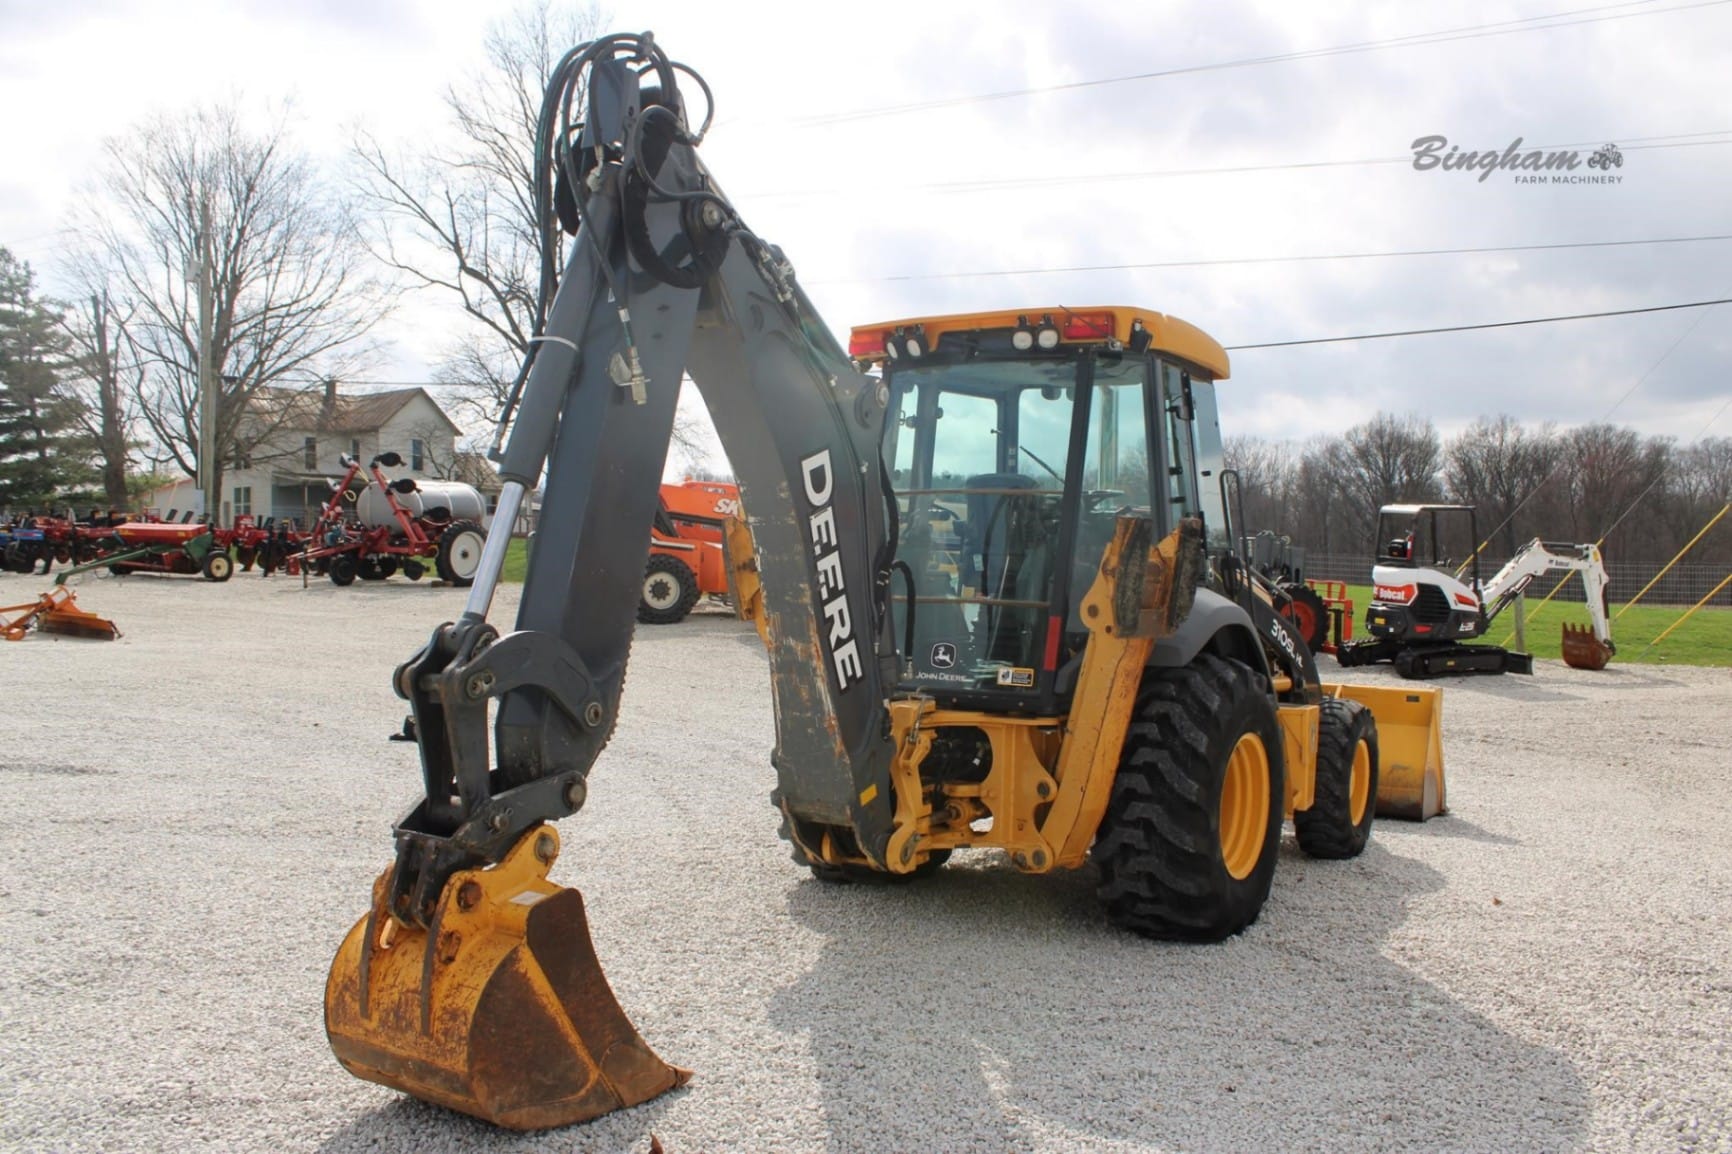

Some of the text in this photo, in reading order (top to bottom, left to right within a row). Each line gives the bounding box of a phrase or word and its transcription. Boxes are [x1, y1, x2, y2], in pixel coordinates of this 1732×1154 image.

[801, 449, 863, 691] DEERE
[1379, 588, 1405, 601] Bobcat
[915, 671, 938, 681] JOHN
